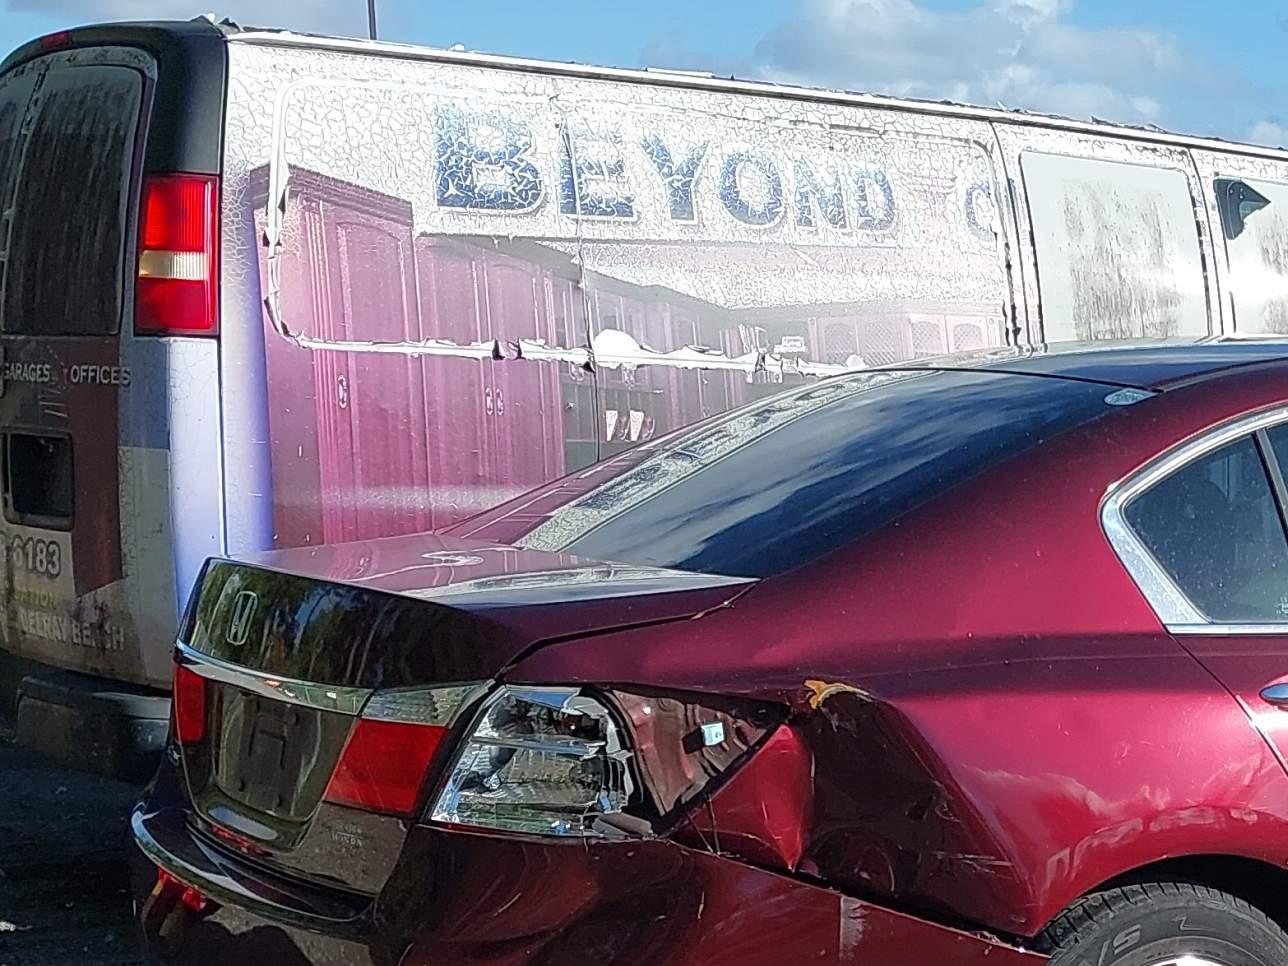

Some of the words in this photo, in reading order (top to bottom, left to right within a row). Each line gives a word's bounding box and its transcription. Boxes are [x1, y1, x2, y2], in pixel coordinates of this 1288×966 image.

[432, 104, 897, 231] BEYOND
[70, 364, 131, 386] OFFICES
[71, 618, 124, 650] BECH
